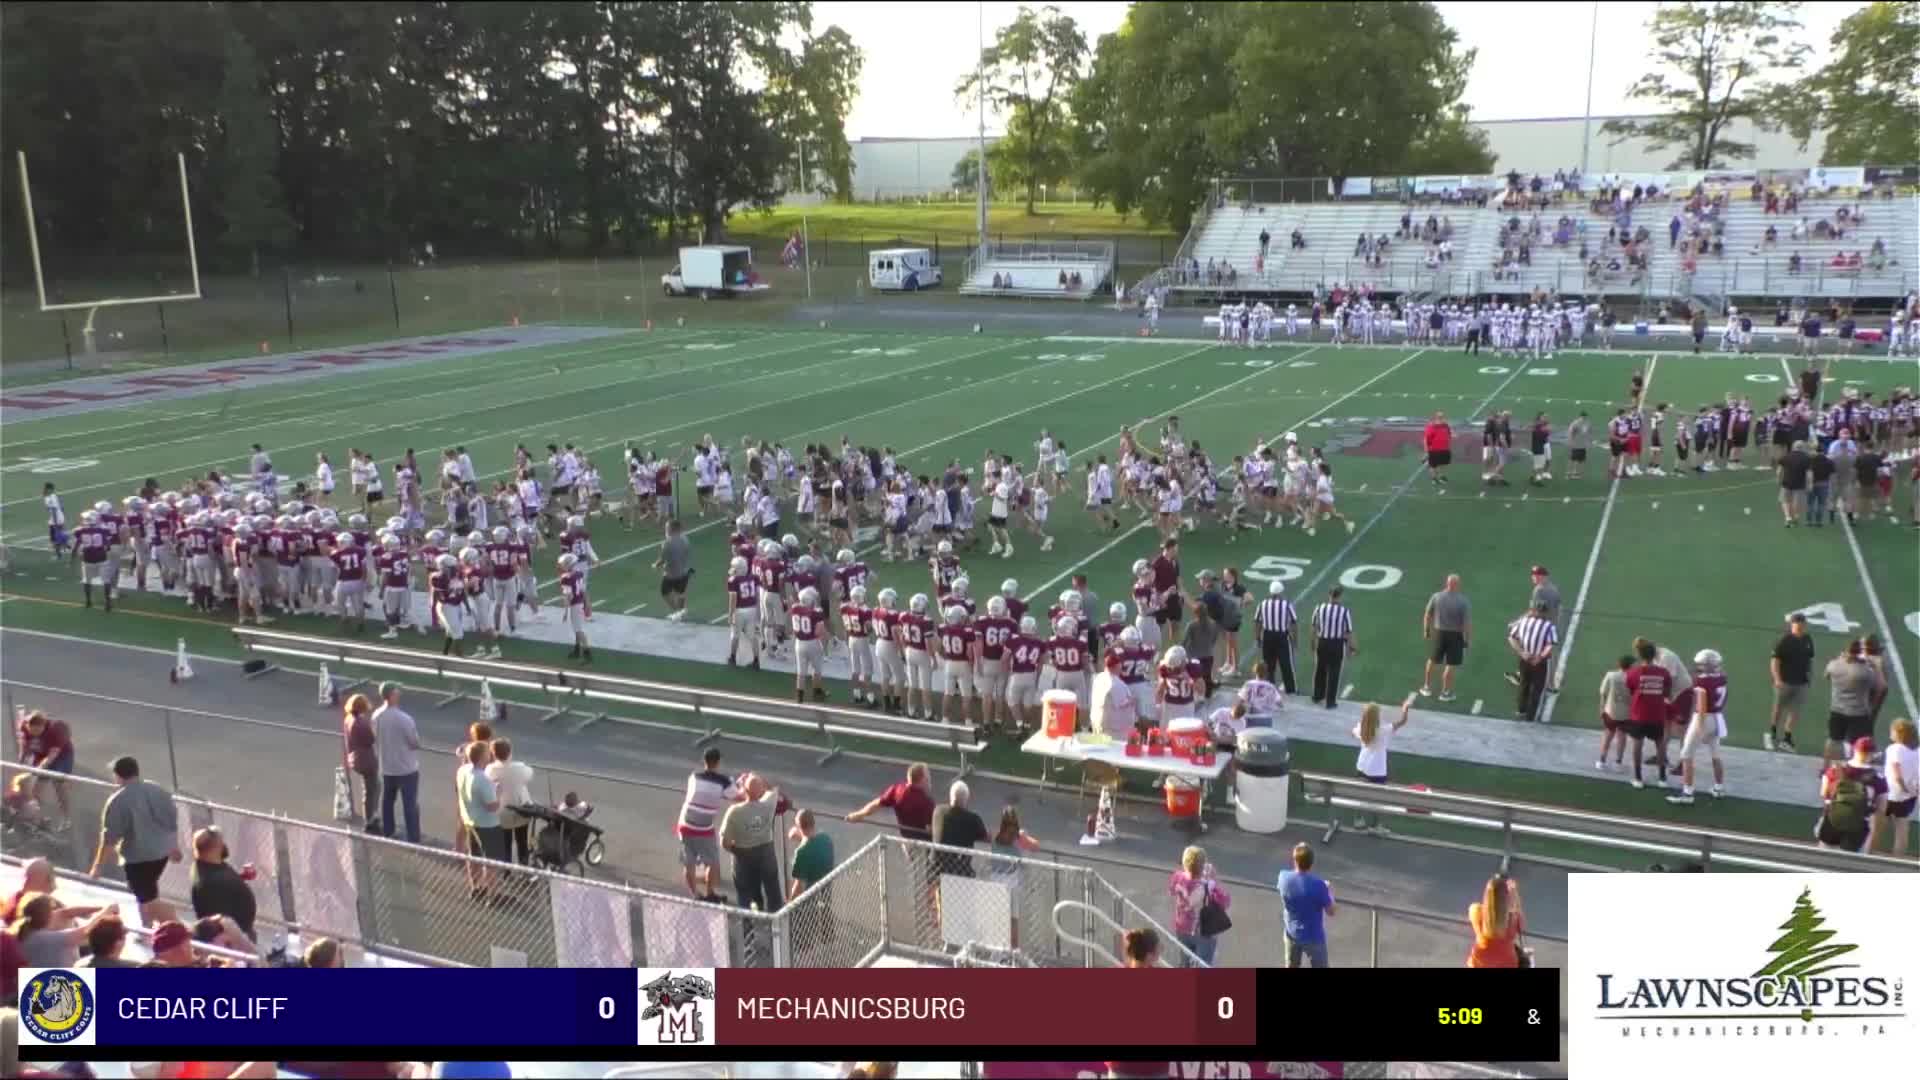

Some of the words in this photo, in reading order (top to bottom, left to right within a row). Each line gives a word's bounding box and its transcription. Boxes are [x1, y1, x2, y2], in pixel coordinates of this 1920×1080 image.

[340, 553, 359, 570] 71
[1243, 555, 1403, 590] 50
[1015, 645, 1040, 664] 44
